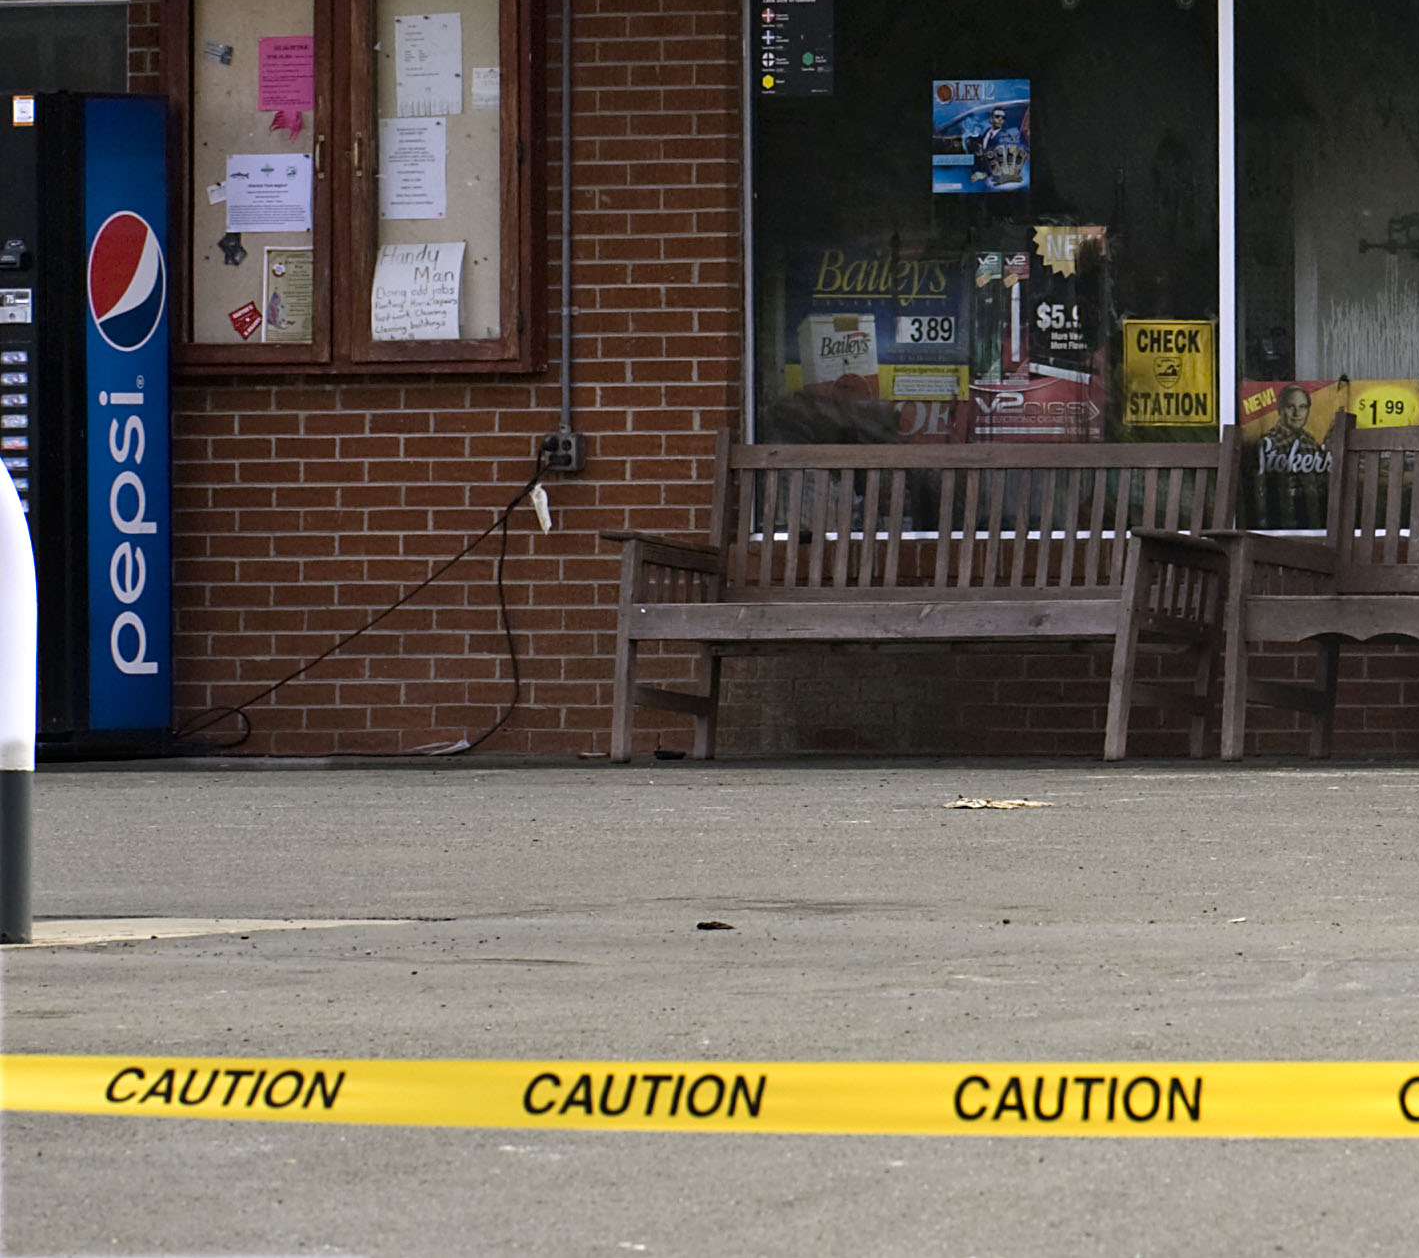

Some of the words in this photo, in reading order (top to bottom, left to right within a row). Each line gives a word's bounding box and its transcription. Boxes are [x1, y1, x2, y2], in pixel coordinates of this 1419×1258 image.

[381, 244, 440, 271] Handy
[414, 266, 454, 284] Man
[1136, 329, 1201, 354] CHECK
[1128, 391, 1208, 417] STATION
[1242, 387, 1277, 415] NEW!
[1359, 399, 1404, 426] $1.99
[99, 390, 159, 675] pepsi
[105, 1066, 344, 1112] CAUTION
[522, 1073, 766, 1119] CAUTION
[953, 1075, 1203, 1123] CAUTION
